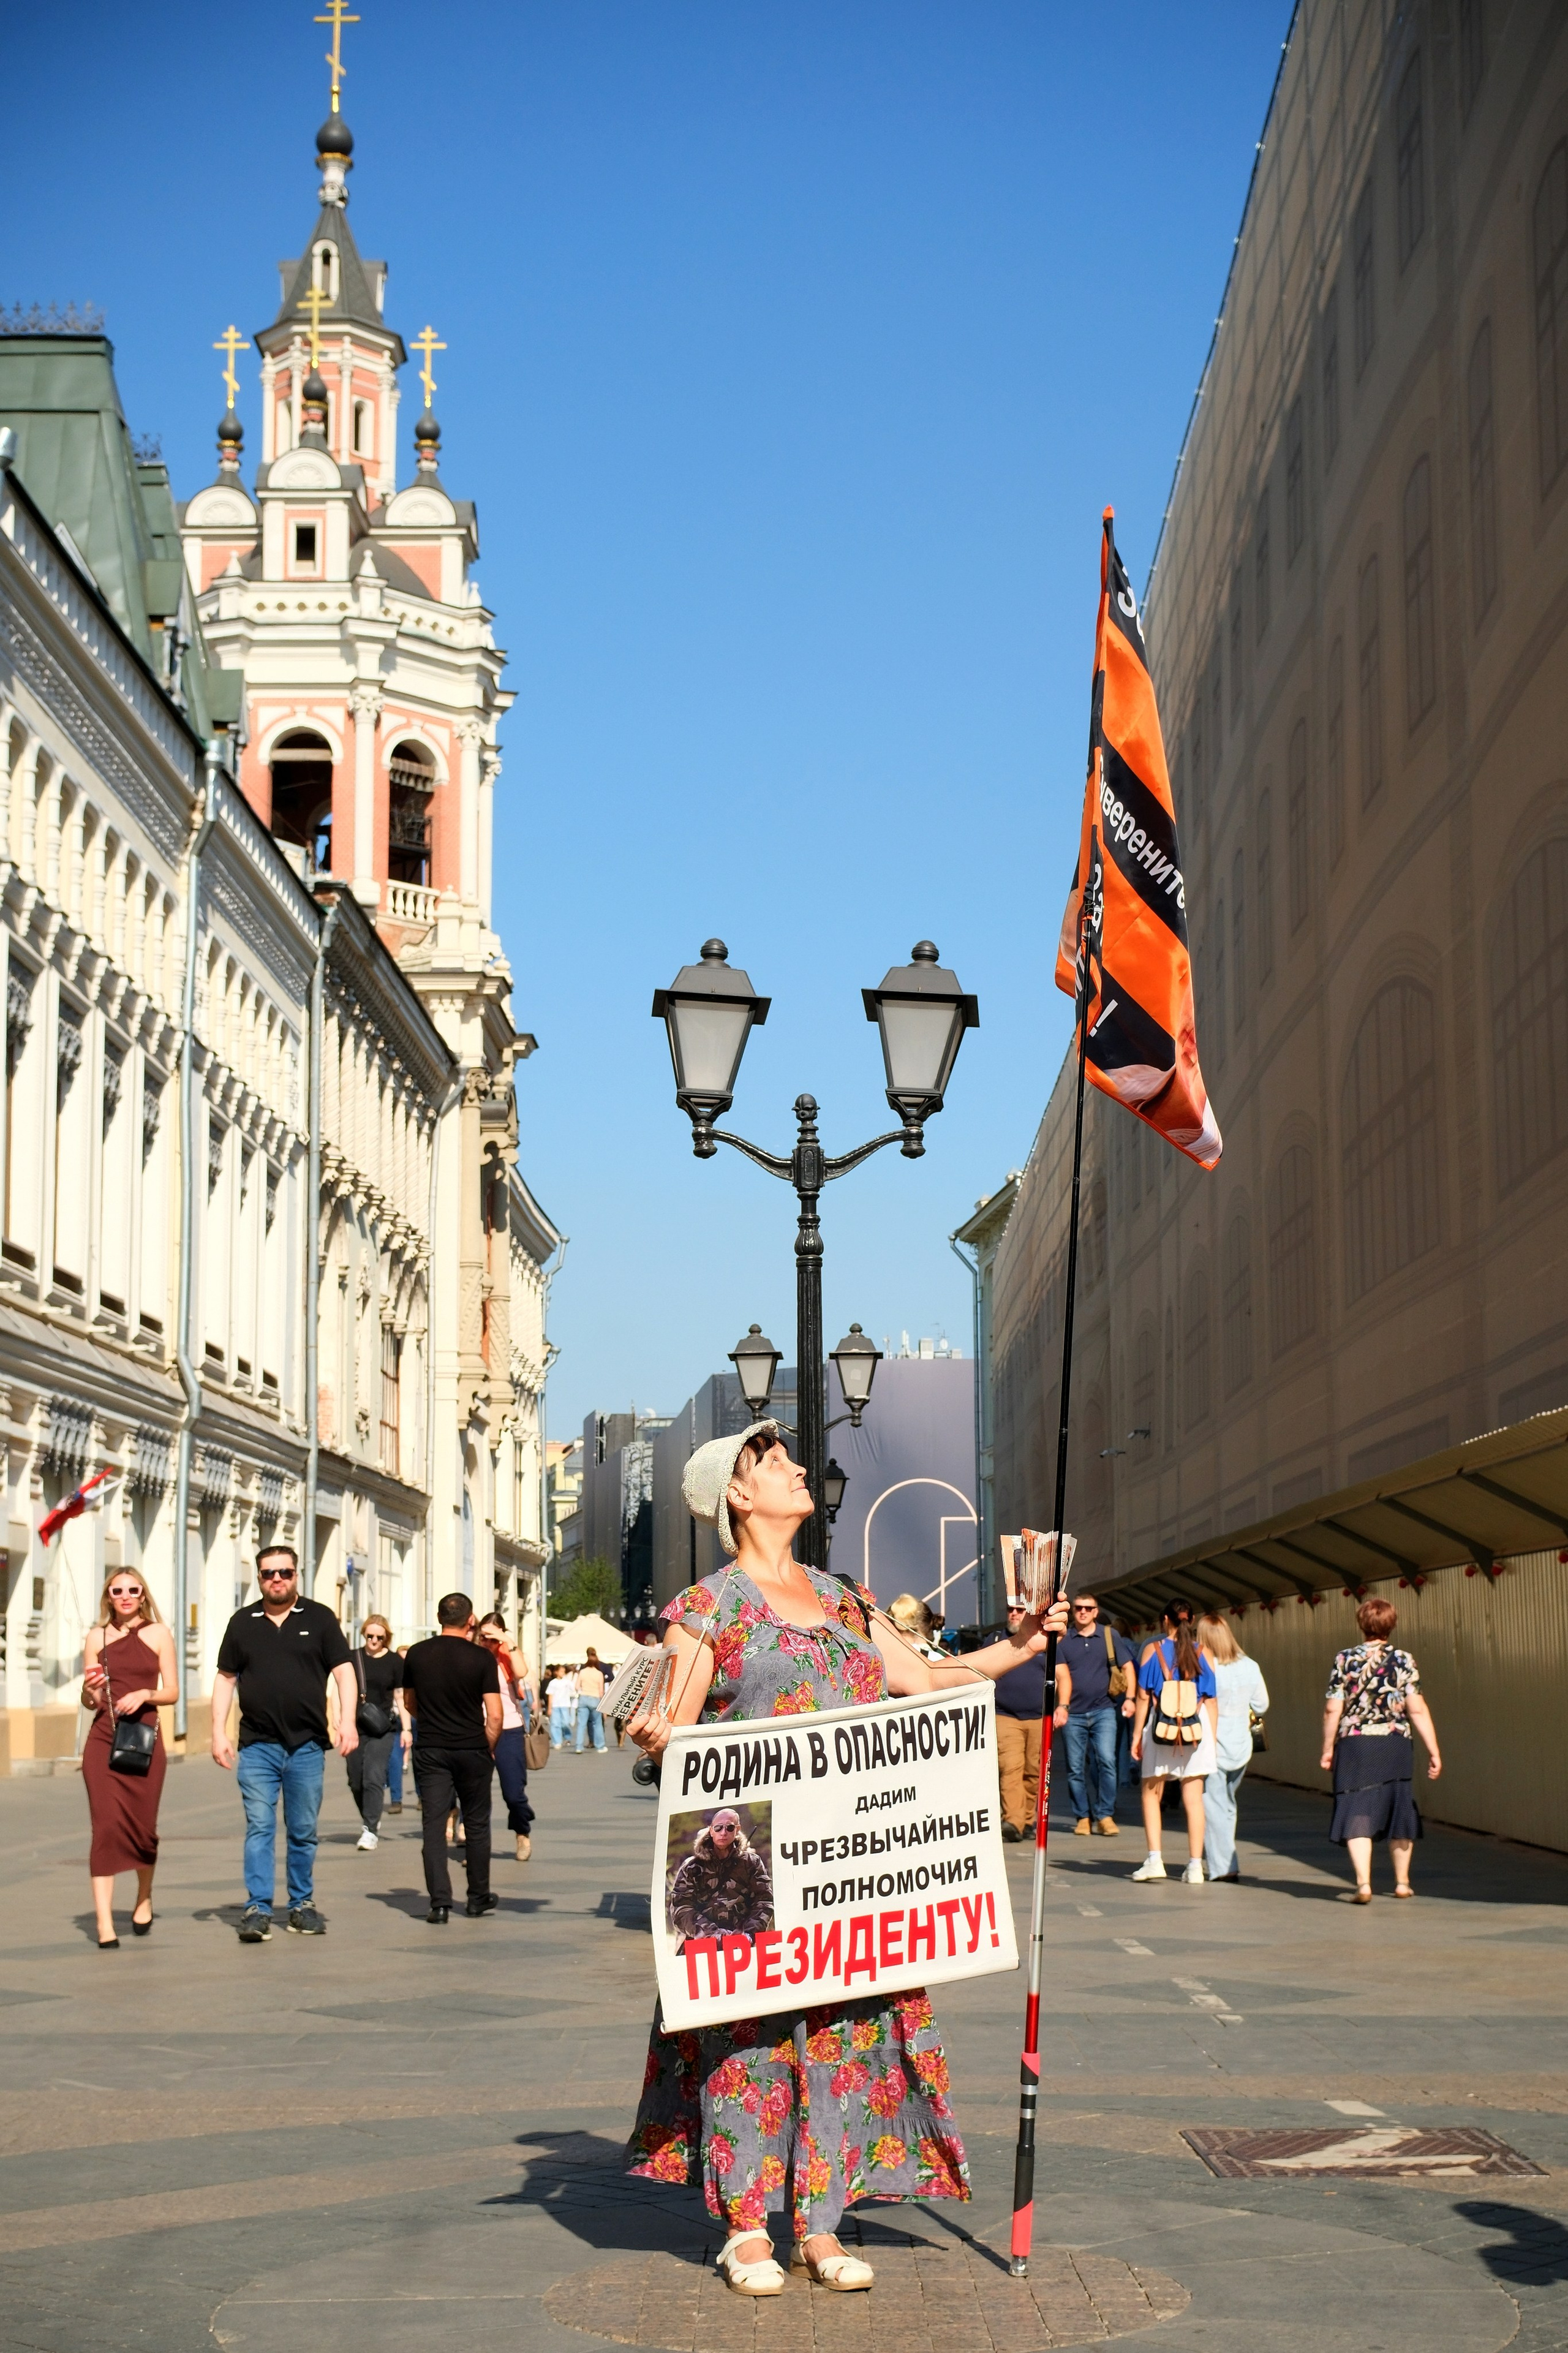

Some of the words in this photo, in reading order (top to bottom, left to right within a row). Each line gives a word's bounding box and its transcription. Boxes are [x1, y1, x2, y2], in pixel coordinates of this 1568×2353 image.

[635, 1656, 649, 1675] КУРС
[682, 1735, 801, 1800] РОДИНА
[806, 1732, 828, 1778] В
[834, 1704, 986, 1775] ОПАСНОСТИ!
[855, 1786, 916, 1815] ДАДИМ
[780, 1808, 990, 1866] ЧРЕЗВЫЧАЙНЫЕ
[802, 1856, 978, 1911] ПОЛНОМОЧИЯ
[684, 1891, 1000, 2000] ПРЕЗИДЕНТУ!
